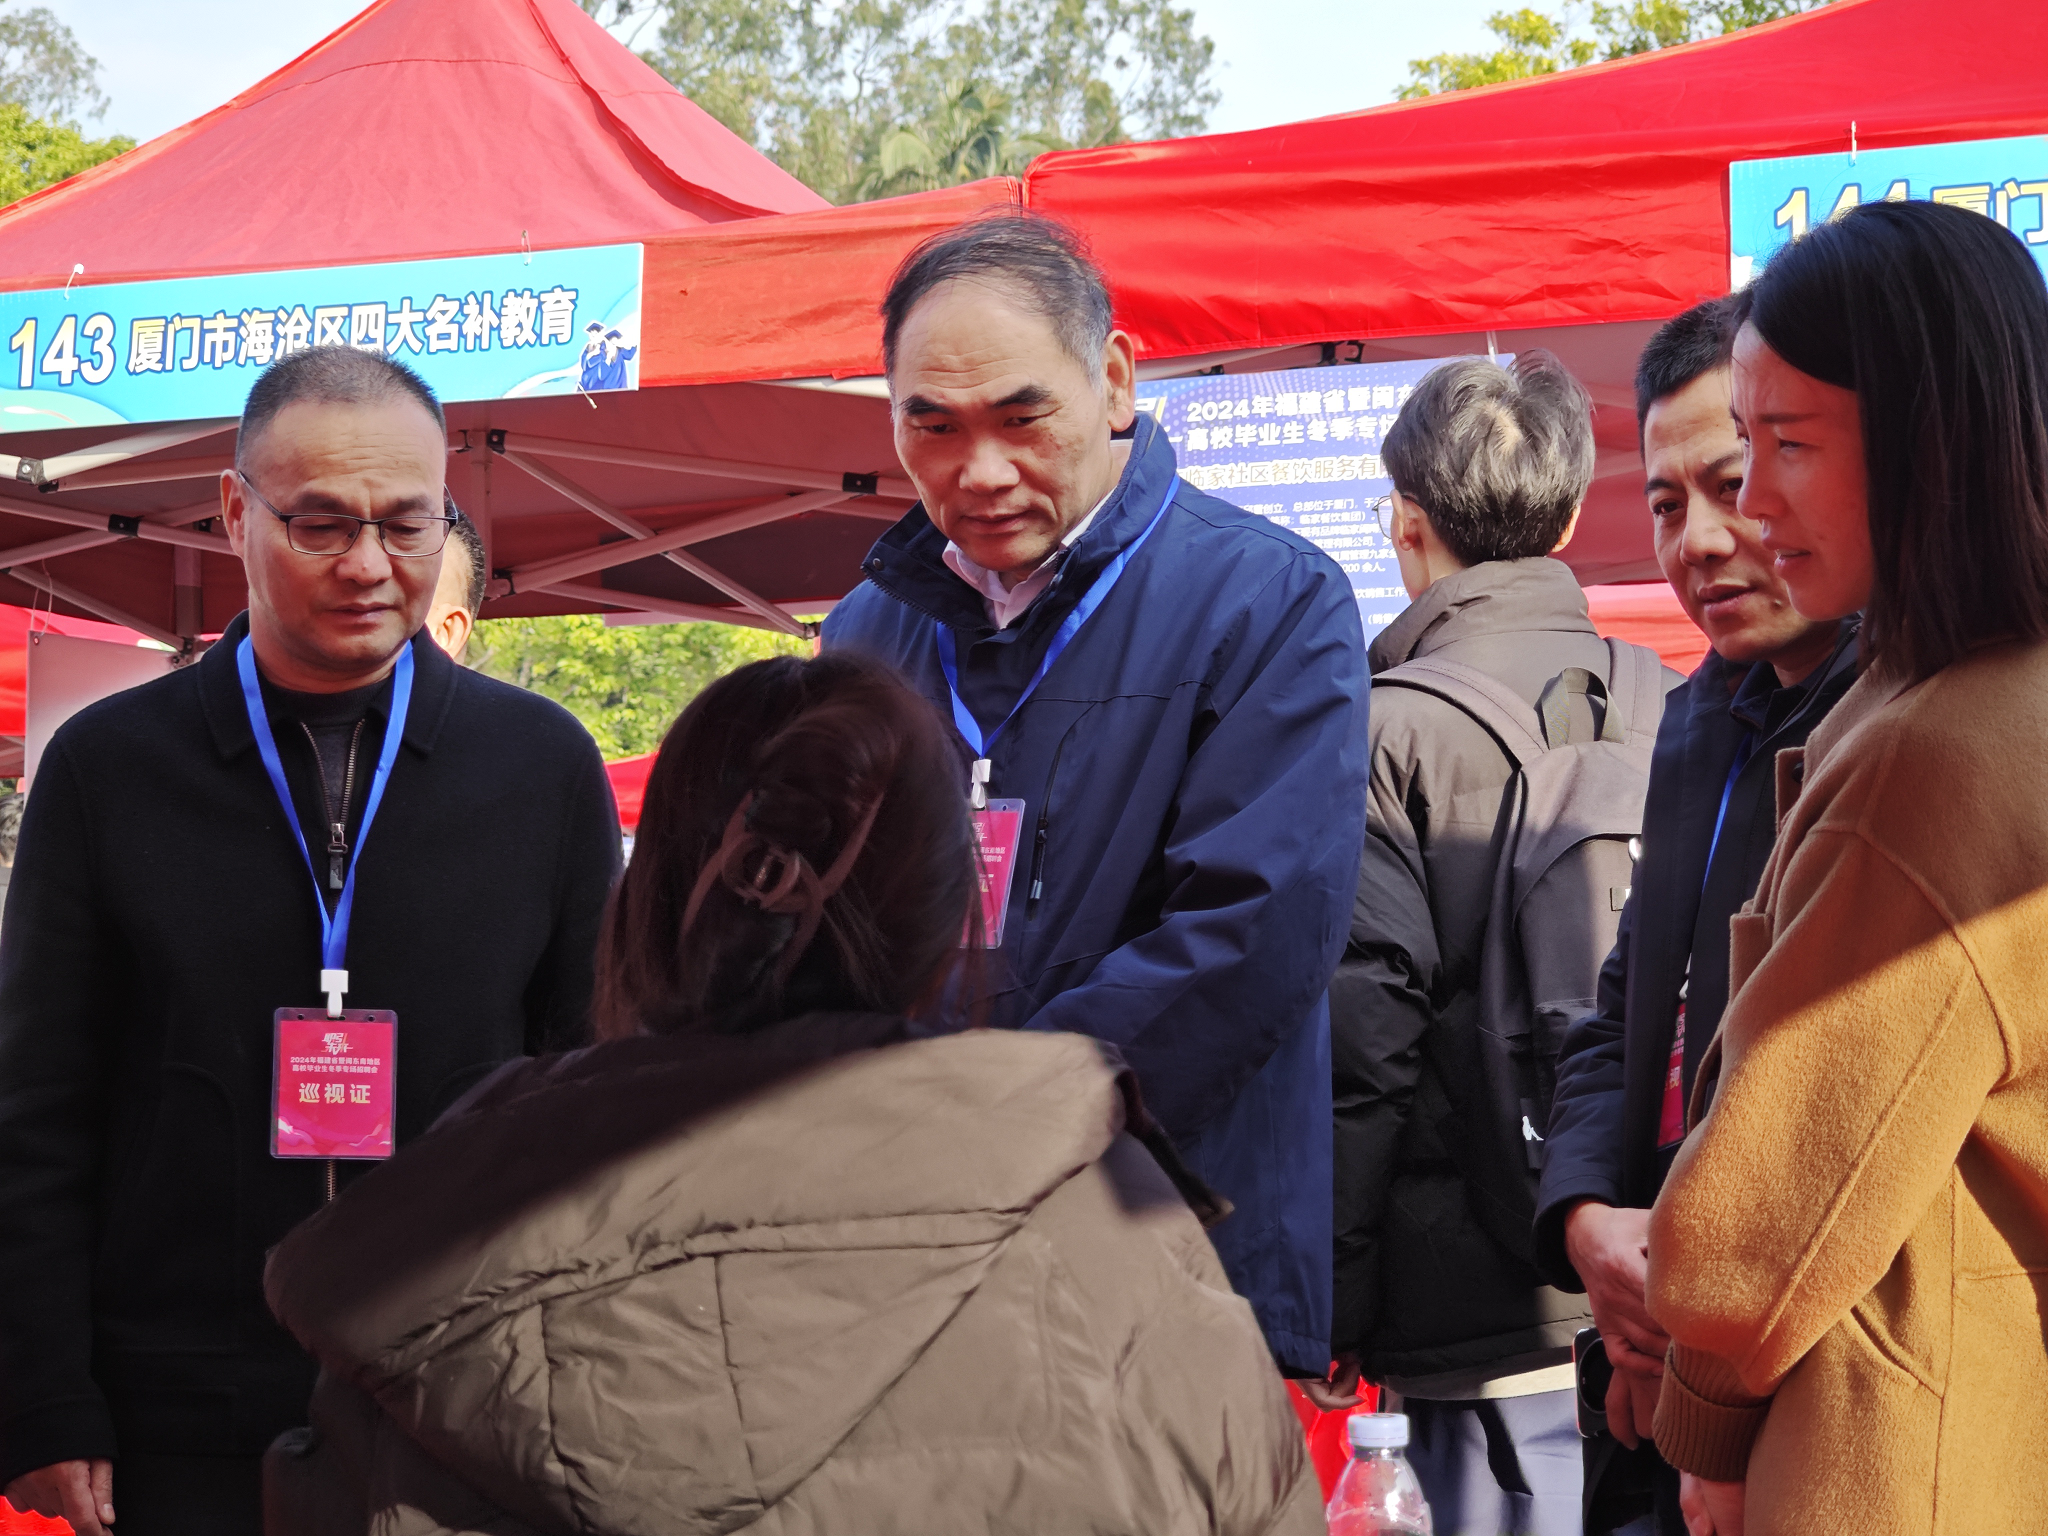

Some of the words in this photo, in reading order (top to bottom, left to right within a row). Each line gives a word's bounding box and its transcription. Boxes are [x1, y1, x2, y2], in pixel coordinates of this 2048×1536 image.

[1931, 178, 2048, 245] 门
[9, 313, 116, 388] 143
[126, 286, 578, 374] 厦门市海沧区四大名补教育
[1177, 455, 1391, 489] 临家社区餐饮服务有
[299, 1083, 371, 1104] 巡视证
